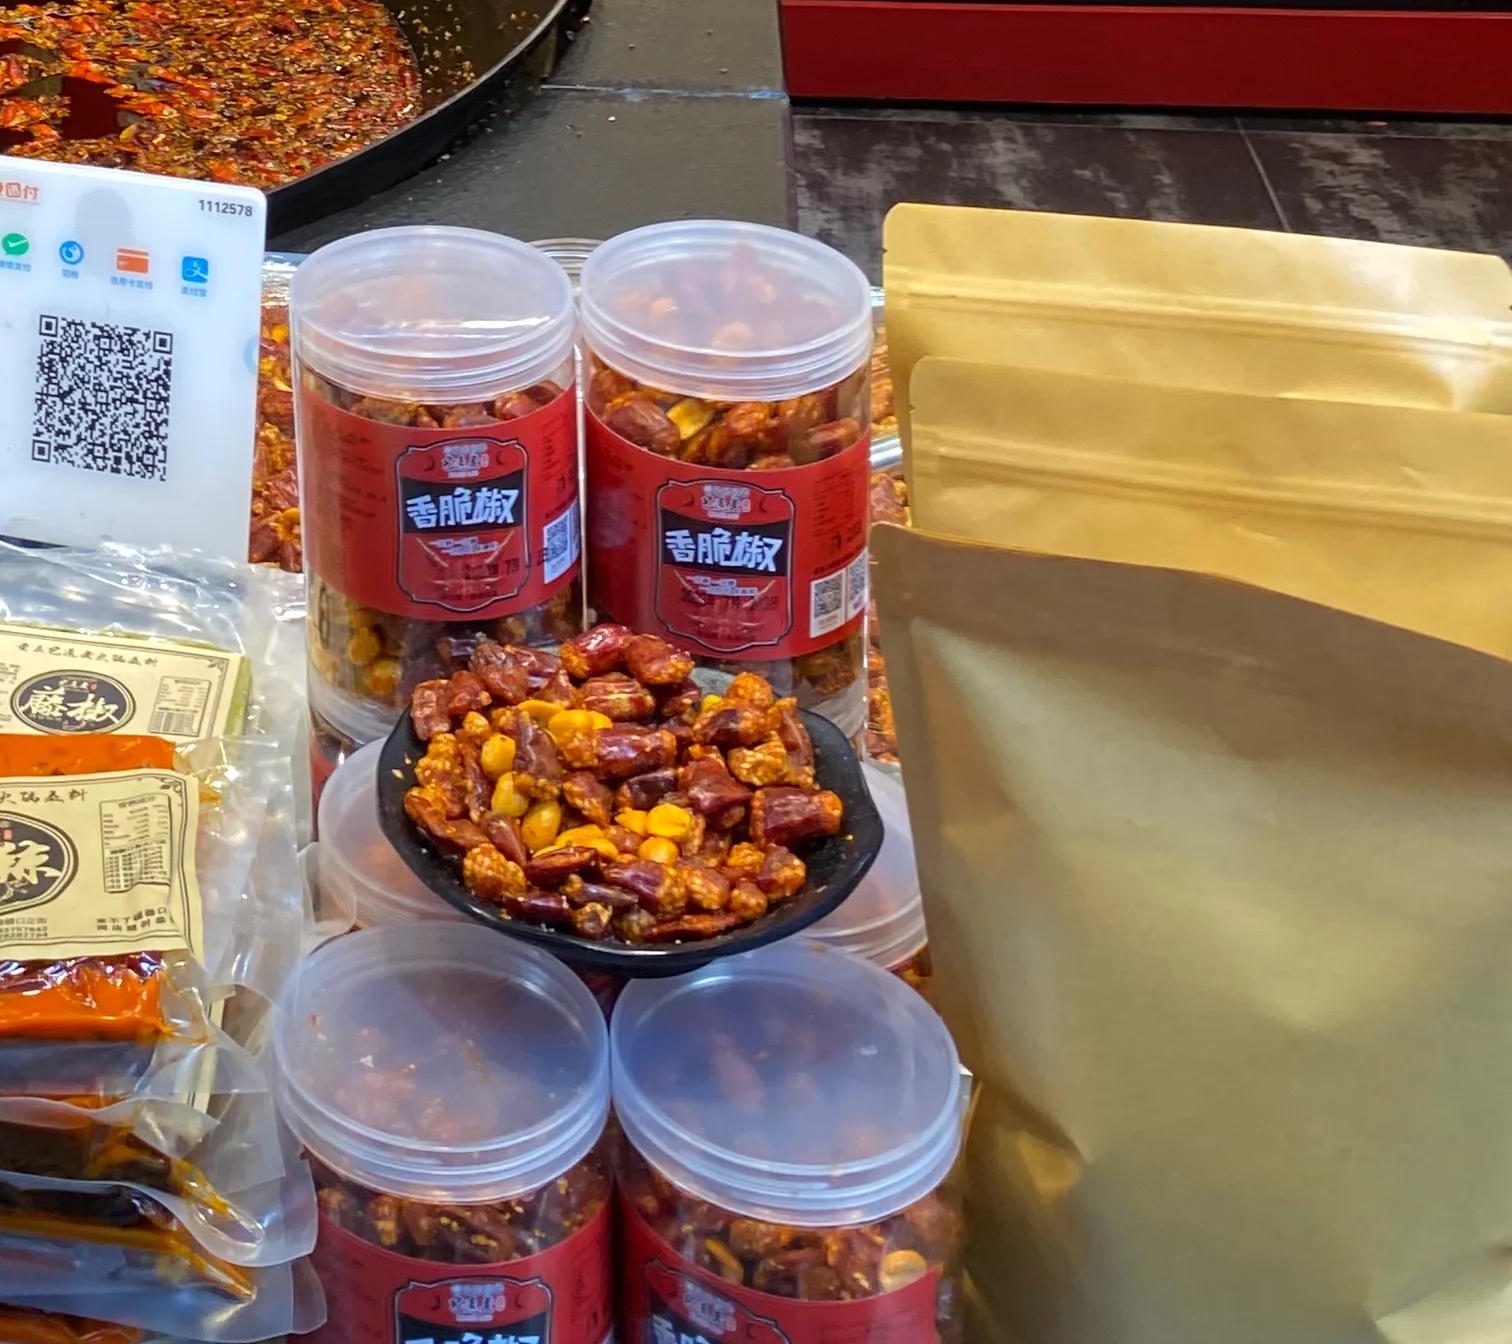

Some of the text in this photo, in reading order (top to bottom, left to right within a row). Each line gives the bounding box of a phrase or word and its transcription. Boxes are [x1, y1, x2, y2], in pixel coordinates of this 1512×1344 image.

[198, 198, 253, 217] 1112578
[405, 485, 521, 531] 香脆椒
[664, 526, 784, 573] 香脆椒
